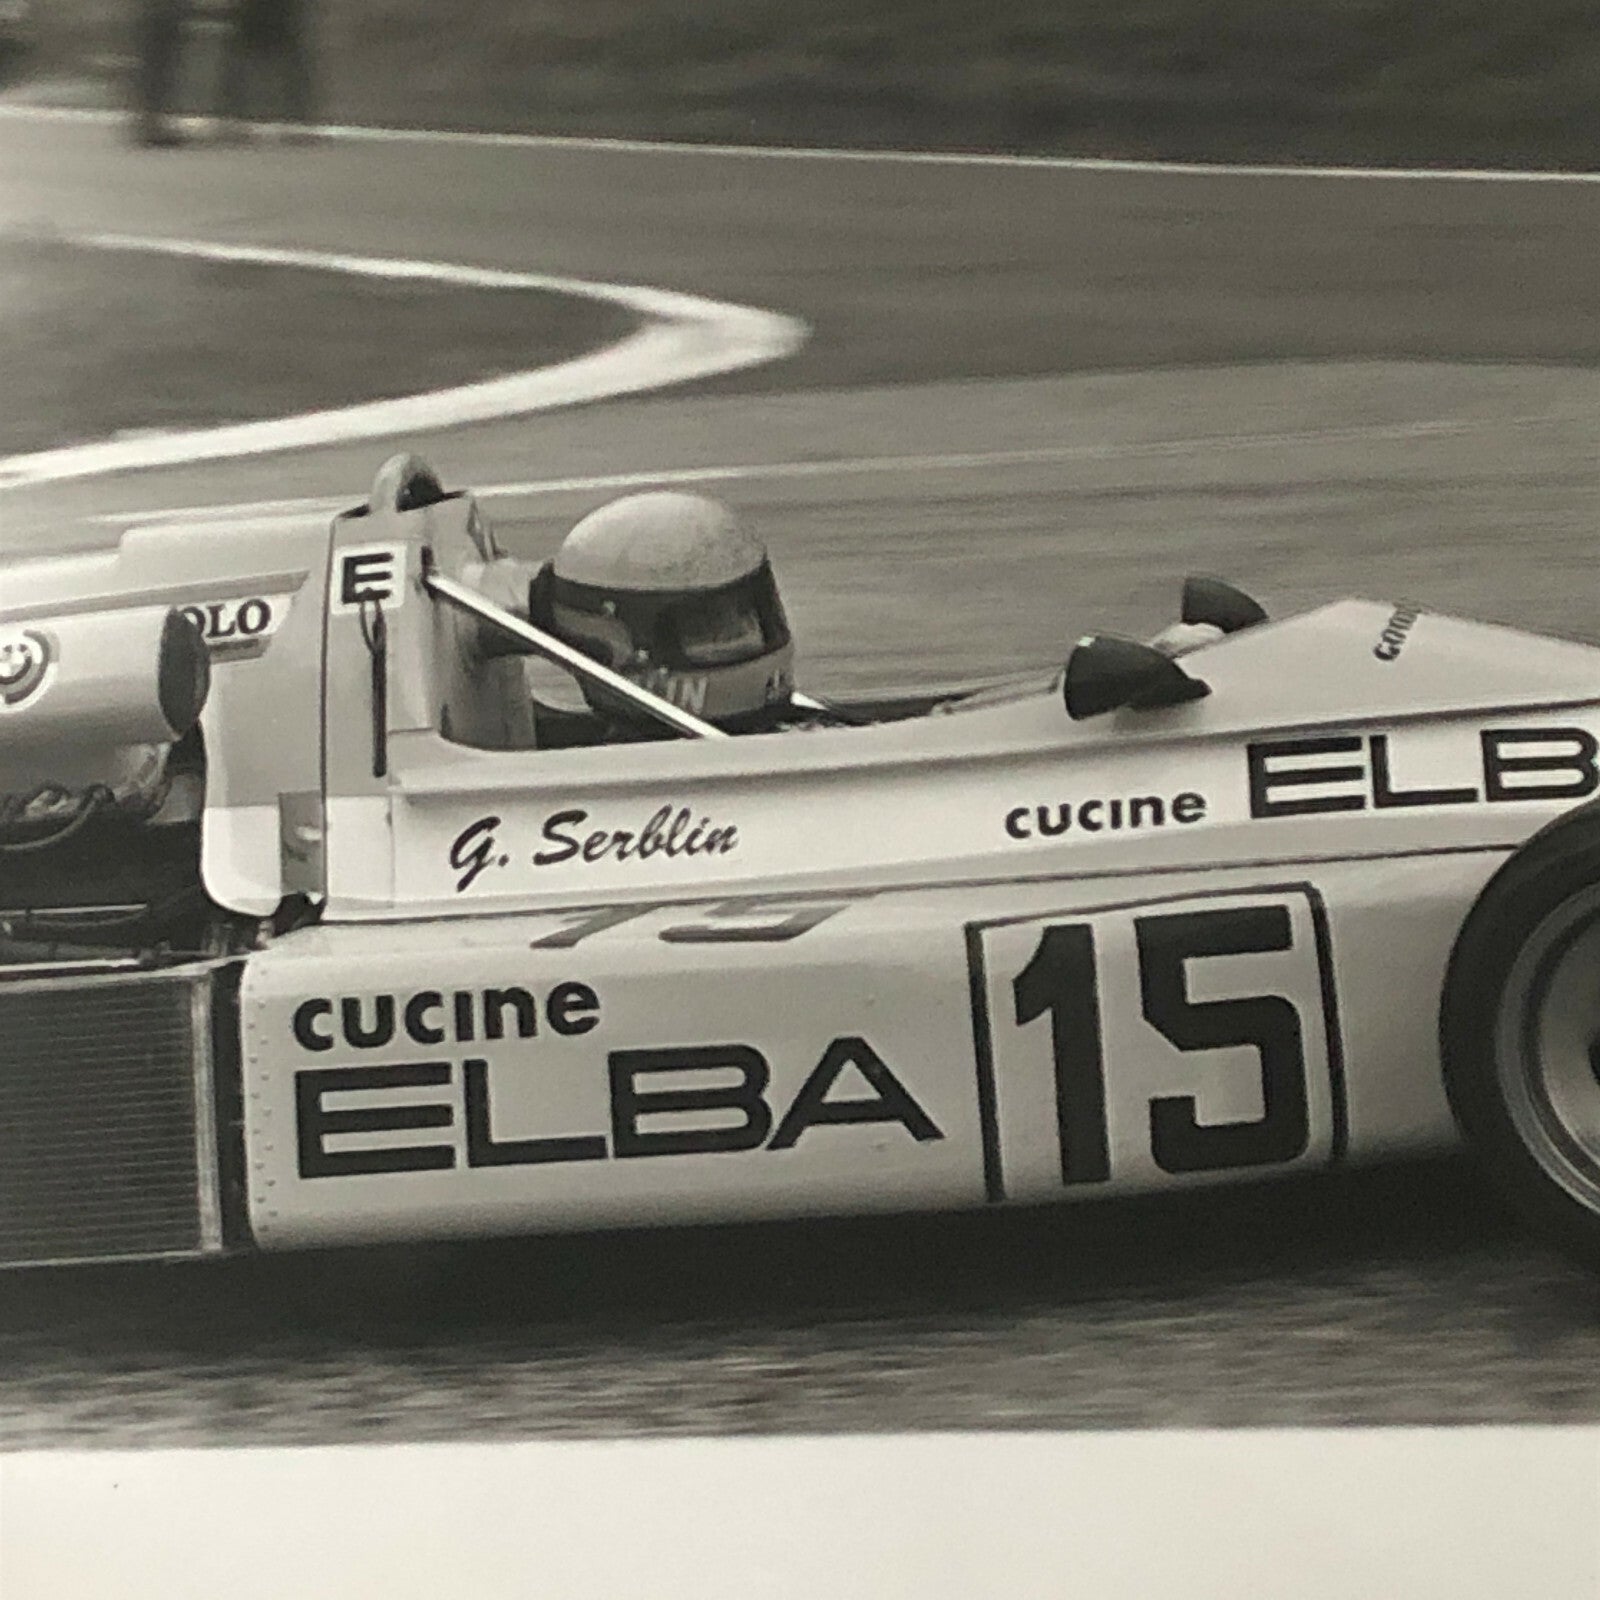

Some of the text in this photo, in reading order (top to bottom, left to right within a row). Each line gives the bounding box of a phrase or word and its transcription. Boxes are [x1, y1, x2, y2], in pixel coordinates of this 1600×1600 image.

[342, 552, 394, 604] E
[533, 804, 738, 866] Serblin
[1005, 790, 1206, 839] cucine
[293, 981, 601, 1052] cucine
[1013, 905, 1310, 1186] 15
[295, 1037, 946, 1179] ELBA
